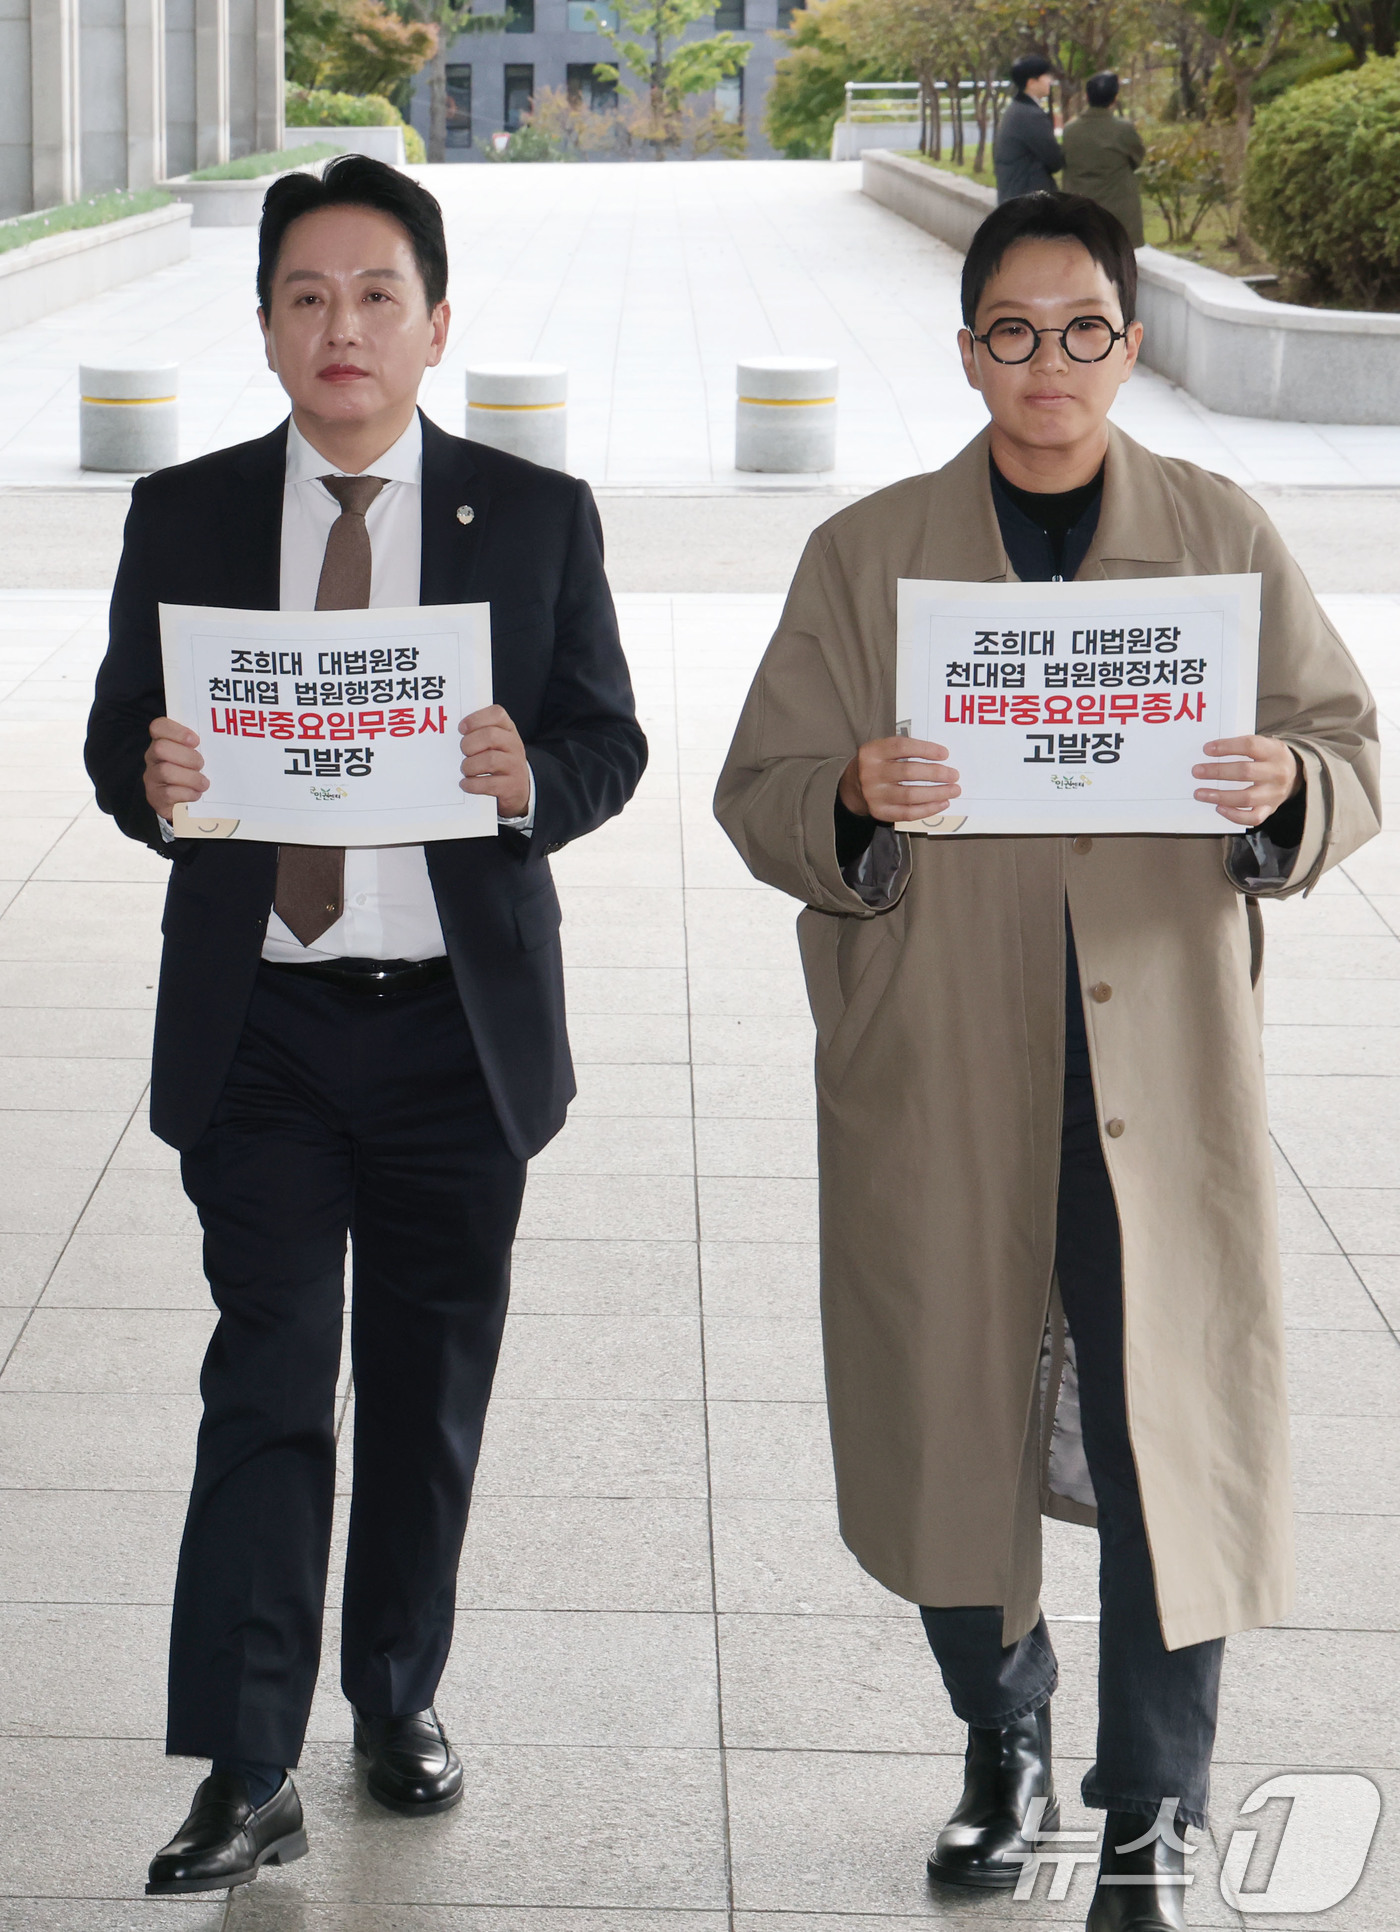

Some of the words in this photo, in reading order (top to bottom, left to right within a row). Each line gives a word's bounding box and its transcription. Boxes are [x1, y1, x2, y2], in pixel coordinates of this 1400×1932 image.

[973, 630, 1055, 657] 조희대
[1071, 627, 1181, 656] 대법원장
[231, 649, 303, 676] 조희대
[318, 647, 420, 676] 대법원장
[945, 661, 1026, 688] 천대엽
[1043, 659, 1207, 688] 법원행정처장
[209, 677, 280, 706] 천대엽
[294, 676, 446, 706] 법원행정처장
[211, 705, 448, 741] 내란중요임무종사
[944, 692, 1207, 726] 내란중요임무종사
[283, 747, 375, 777] 고발장
[1023, 733, 1125, 764] 고발장
